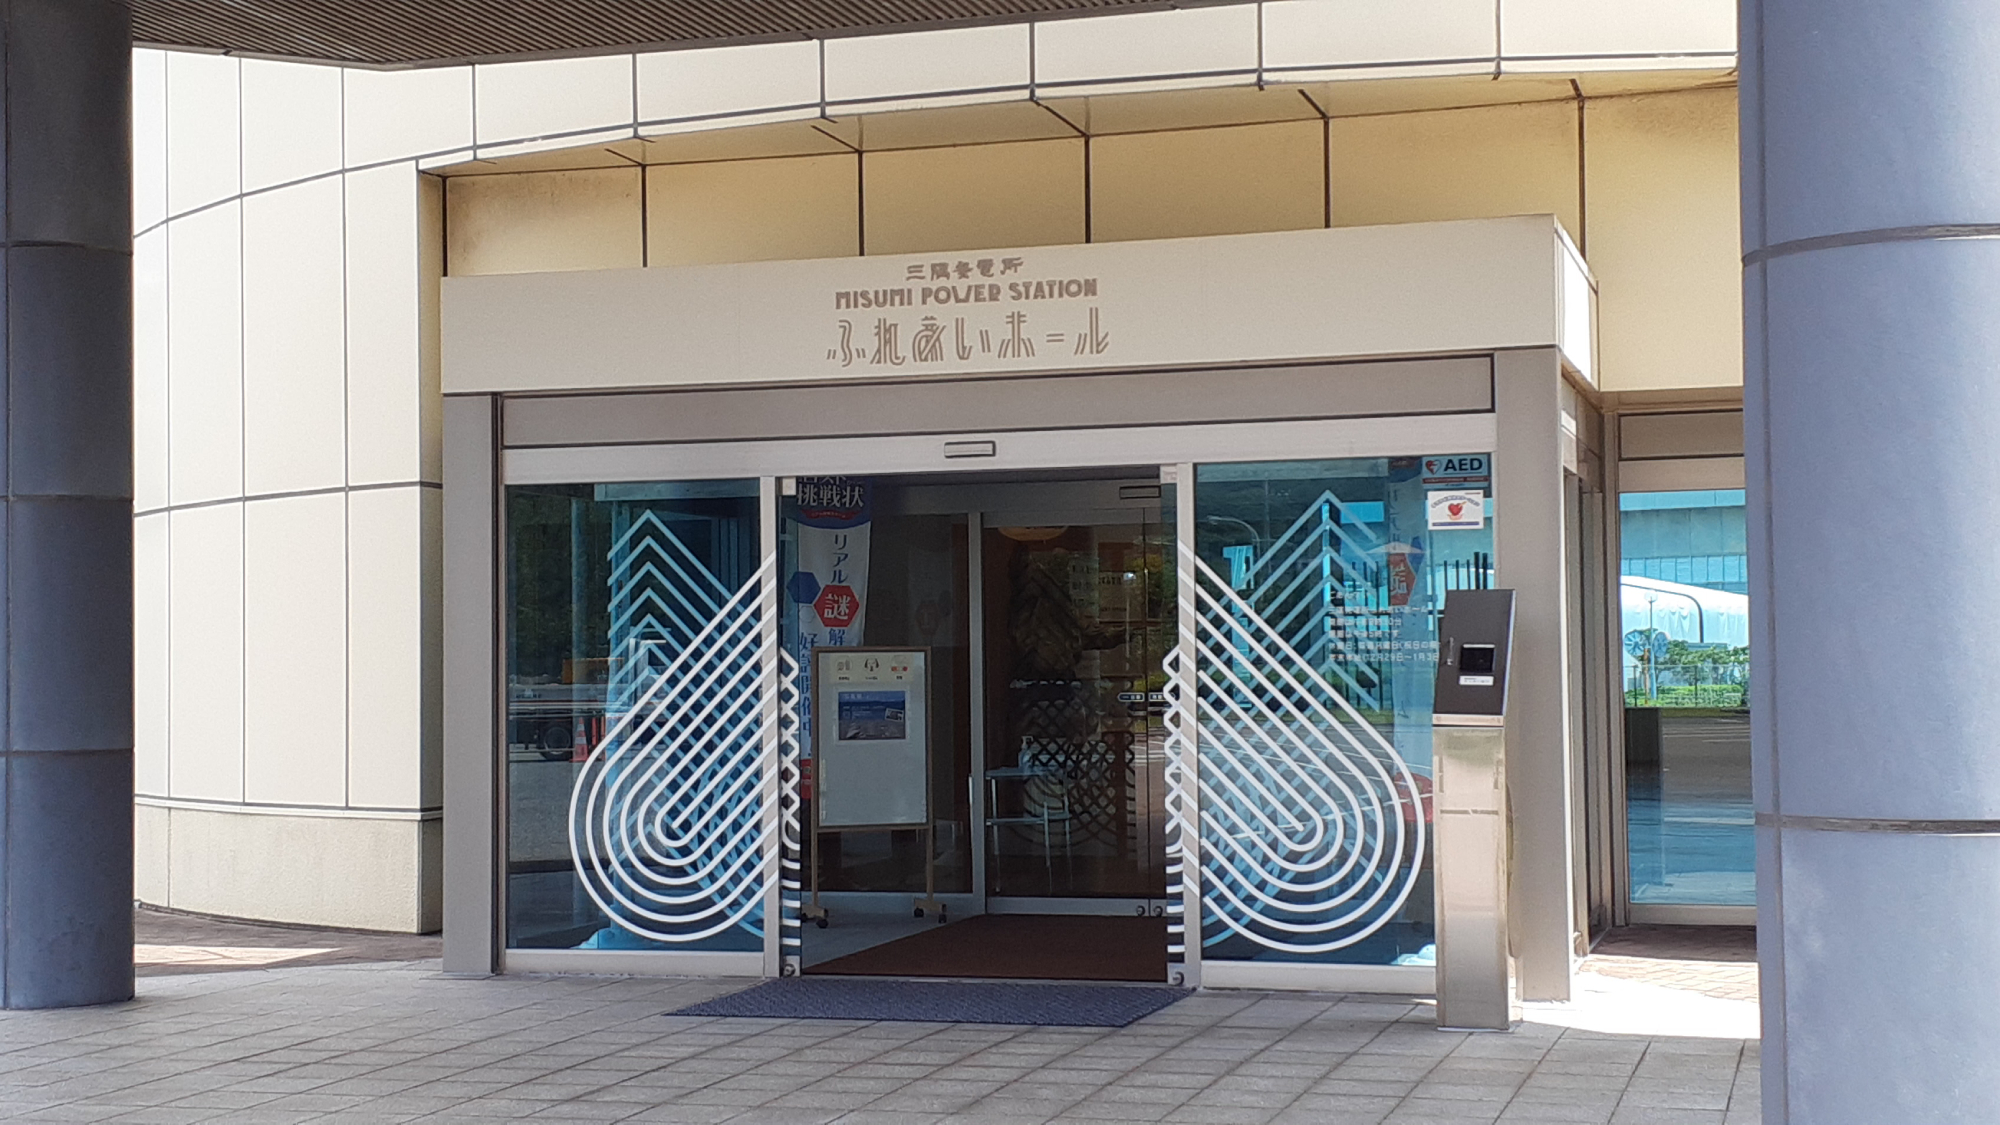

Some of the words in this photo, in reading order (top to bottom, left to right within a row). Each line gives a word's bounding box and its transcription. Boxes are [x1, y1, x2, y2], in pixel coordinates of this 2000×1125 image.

[906, 256, 1023, 282] 三隅発電所
[835, 287, 913, 310] MISUMI
[921, 283, 1001, 305] POWER
[1008, 278, 1098, 300] STATION
[826, 306, 1109, 367] ふれあいホール
[1444, 457, 1483, 472] AED
[797, 484, 864, 508] 挑戦状
